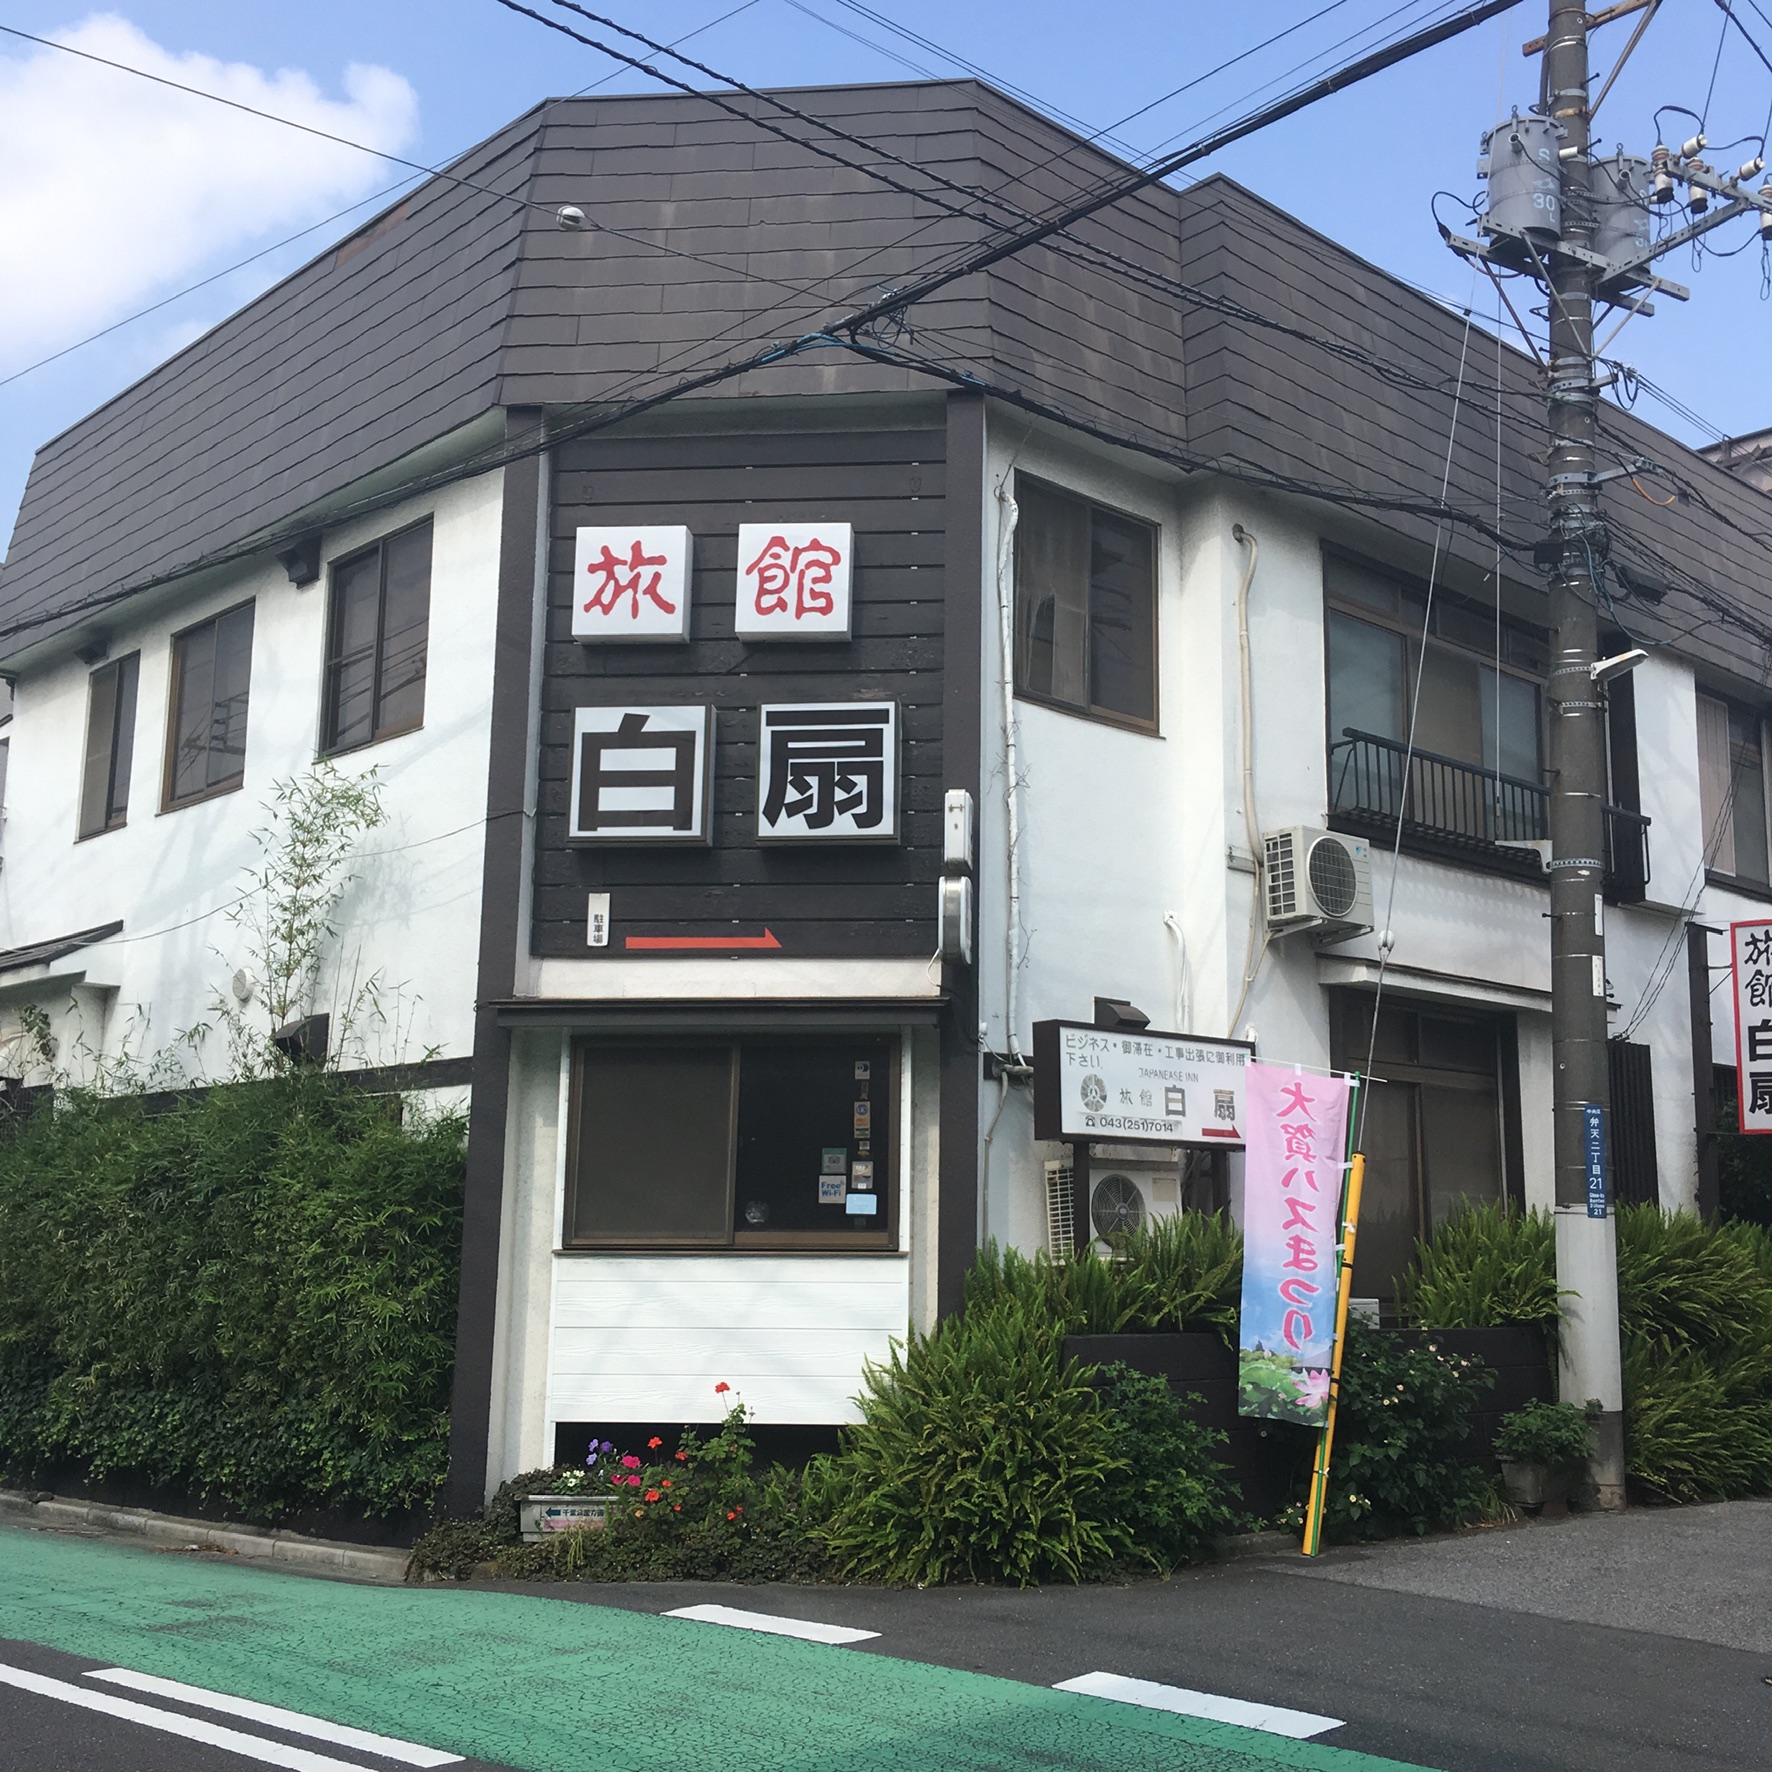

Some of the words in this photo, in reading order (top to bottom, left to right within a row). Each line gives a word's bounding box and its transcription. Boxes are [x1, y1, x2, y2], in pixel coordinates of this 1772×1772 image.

[1532, 192, 1556, 212] 30
[583, 535, 842, 620] 旅館
[577, 708, 890, 832] 白扇
[593, 914, 604, 944] 駐車場
[1185, 1071, 1199, 1083] INN
[1099, 1116, 1174, 1133] 043(251)7014
[821, 1181, 841, 1189] Free
[1589, 1178, 1602, 1190] 21
